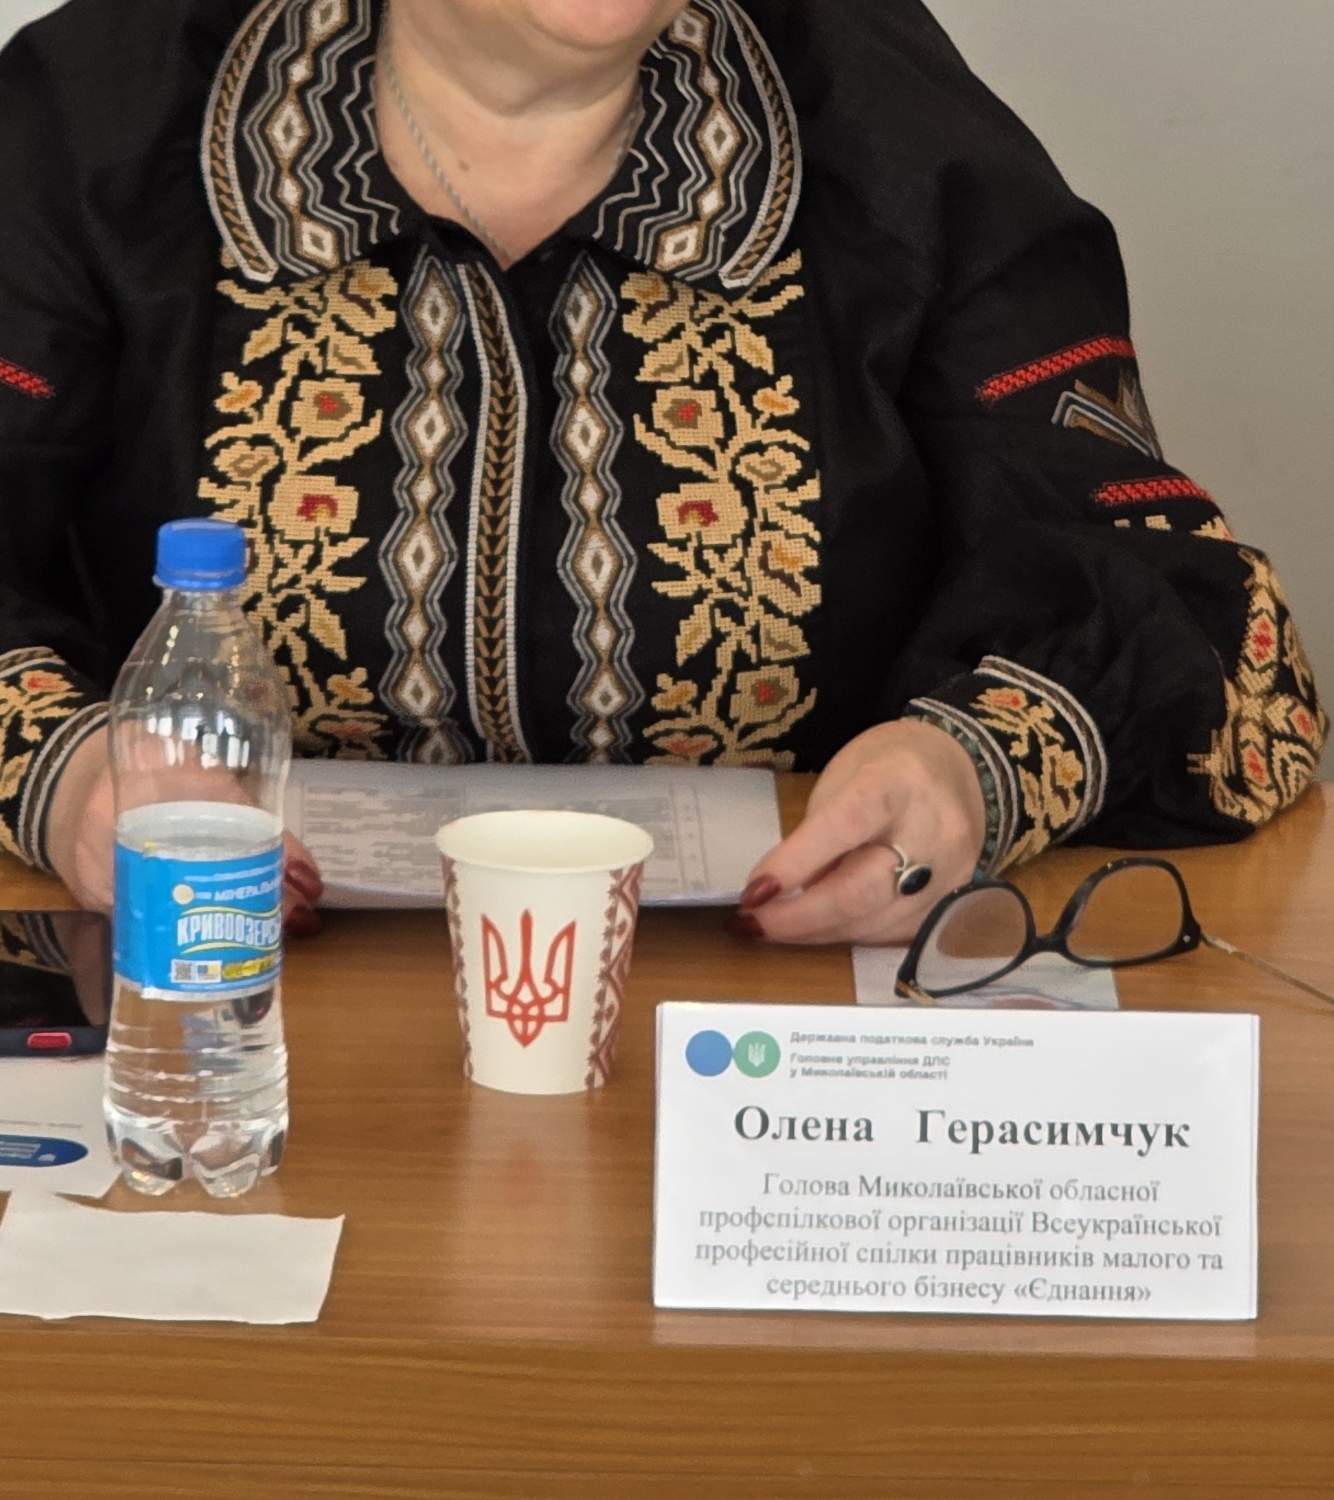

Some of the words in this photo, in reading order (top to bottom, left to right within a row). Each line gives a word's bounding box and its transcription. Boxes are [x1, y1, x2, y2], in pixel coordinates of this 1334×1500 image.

[734, 1105, 875, 1143] Олена
[916, 1109, 1190, 1156] Герасимчук
[763, 1173, 849, 1197] Голова
[858, 1174, 1042, 1201] Миколаївської
[1049, 1176, 1159, 1202] обласної
[699, 1208, 883, 1235] профспілкової
[888, 1210, 1023, 1236] організації
[1031, 1212, 1222, 1240] Всеукраїнської
[695, 1240, 849, 1267] професійної
[856, 1243, 938, 1267] спілки
[945, 1245, 1094, 1269] працівників
[1102, 1248, 1190, 1271] малого
[1198, 1252, 1223, 1269] та
[766, 1277, 906, 1300] середнього
[915, 1276, 1004, 1302] бізнесу
